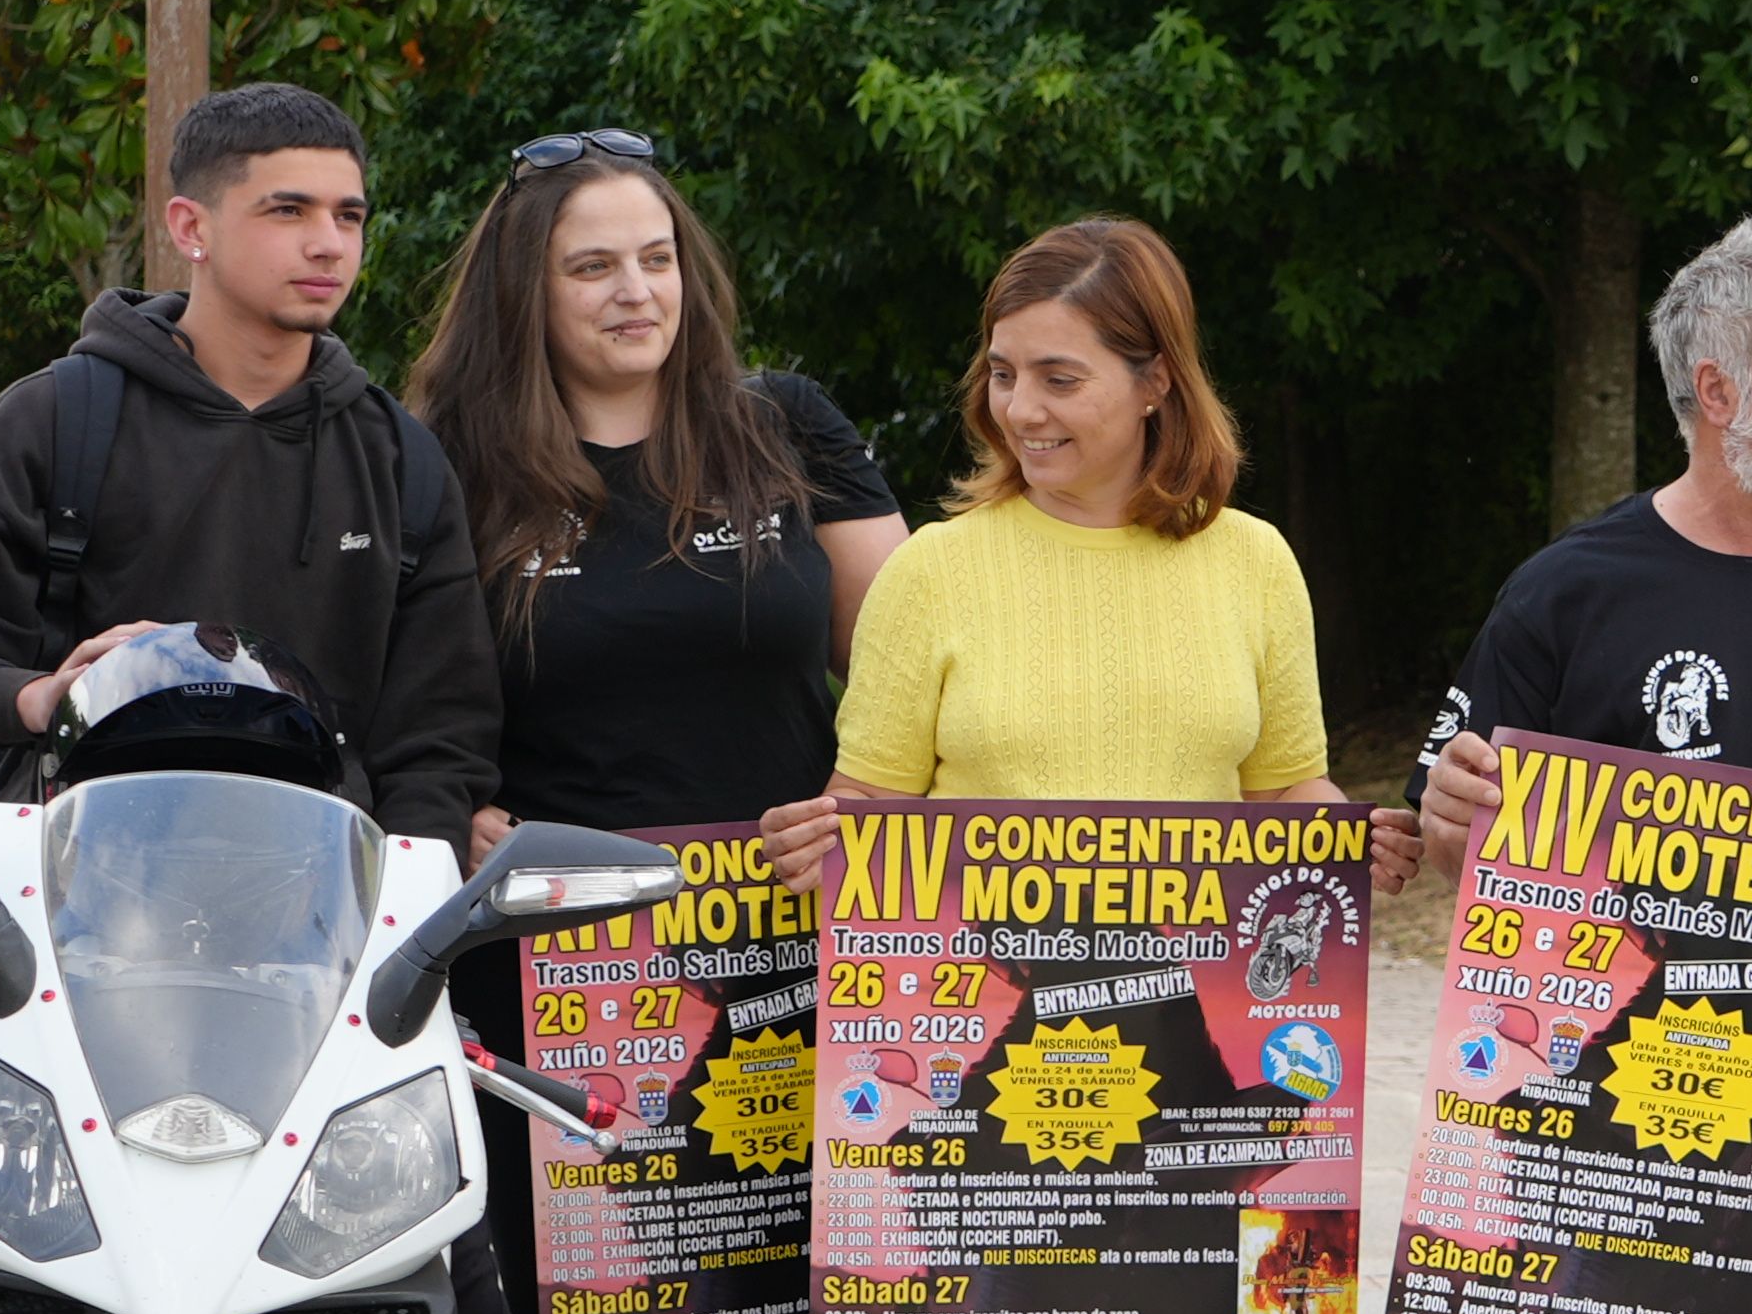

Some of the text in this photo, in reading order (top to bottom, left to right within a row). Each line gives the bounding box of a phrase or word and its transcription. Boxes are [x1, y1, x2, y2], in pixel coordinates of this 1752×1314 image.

[1675, 650, 1696, 662] DO
[1480, 746, 1617, 875] XIV
[834, 807, 1366, 919] XIV CONCENTRACIÓN
[651, 885, 821, 946] MOTEI
[962, 865, 1228, 925] MOTEIRA
[1475, 867, 1585, 914] Trasnos
[1591, 888, 1626, 920] do
[1631, 893, 1725, 936] Salnés
[832, 928, 1228, 960] Trasnos do Salnés Motoclub
[1462, 905, 1624, 971] 26 e 27
[532, 945, 771, 987] Trasnos do Salnés
[830, 963, 986, 1007] 26 e 27
[1457, 961, 1614, 1011] xuño 2026
[1664, 964, 1740, 990] ENTRADA
[534, 985, 682, 1035] 26 e 27
[1033, 968, 1194, 1016] ENTRADA GRATUÍTA
[538, 1035, 686, 1070] xuño 2026
[831, 1016, 984, 1042] xuño 2026
[828, 1137, 966, 1167] Venres 26
[828, 1210, 1106, 1228] 23:00h. RUTA LIBRE NOCTURNA polo pobo.
[1409, 1235, 1558, 1282] Sábado 27
